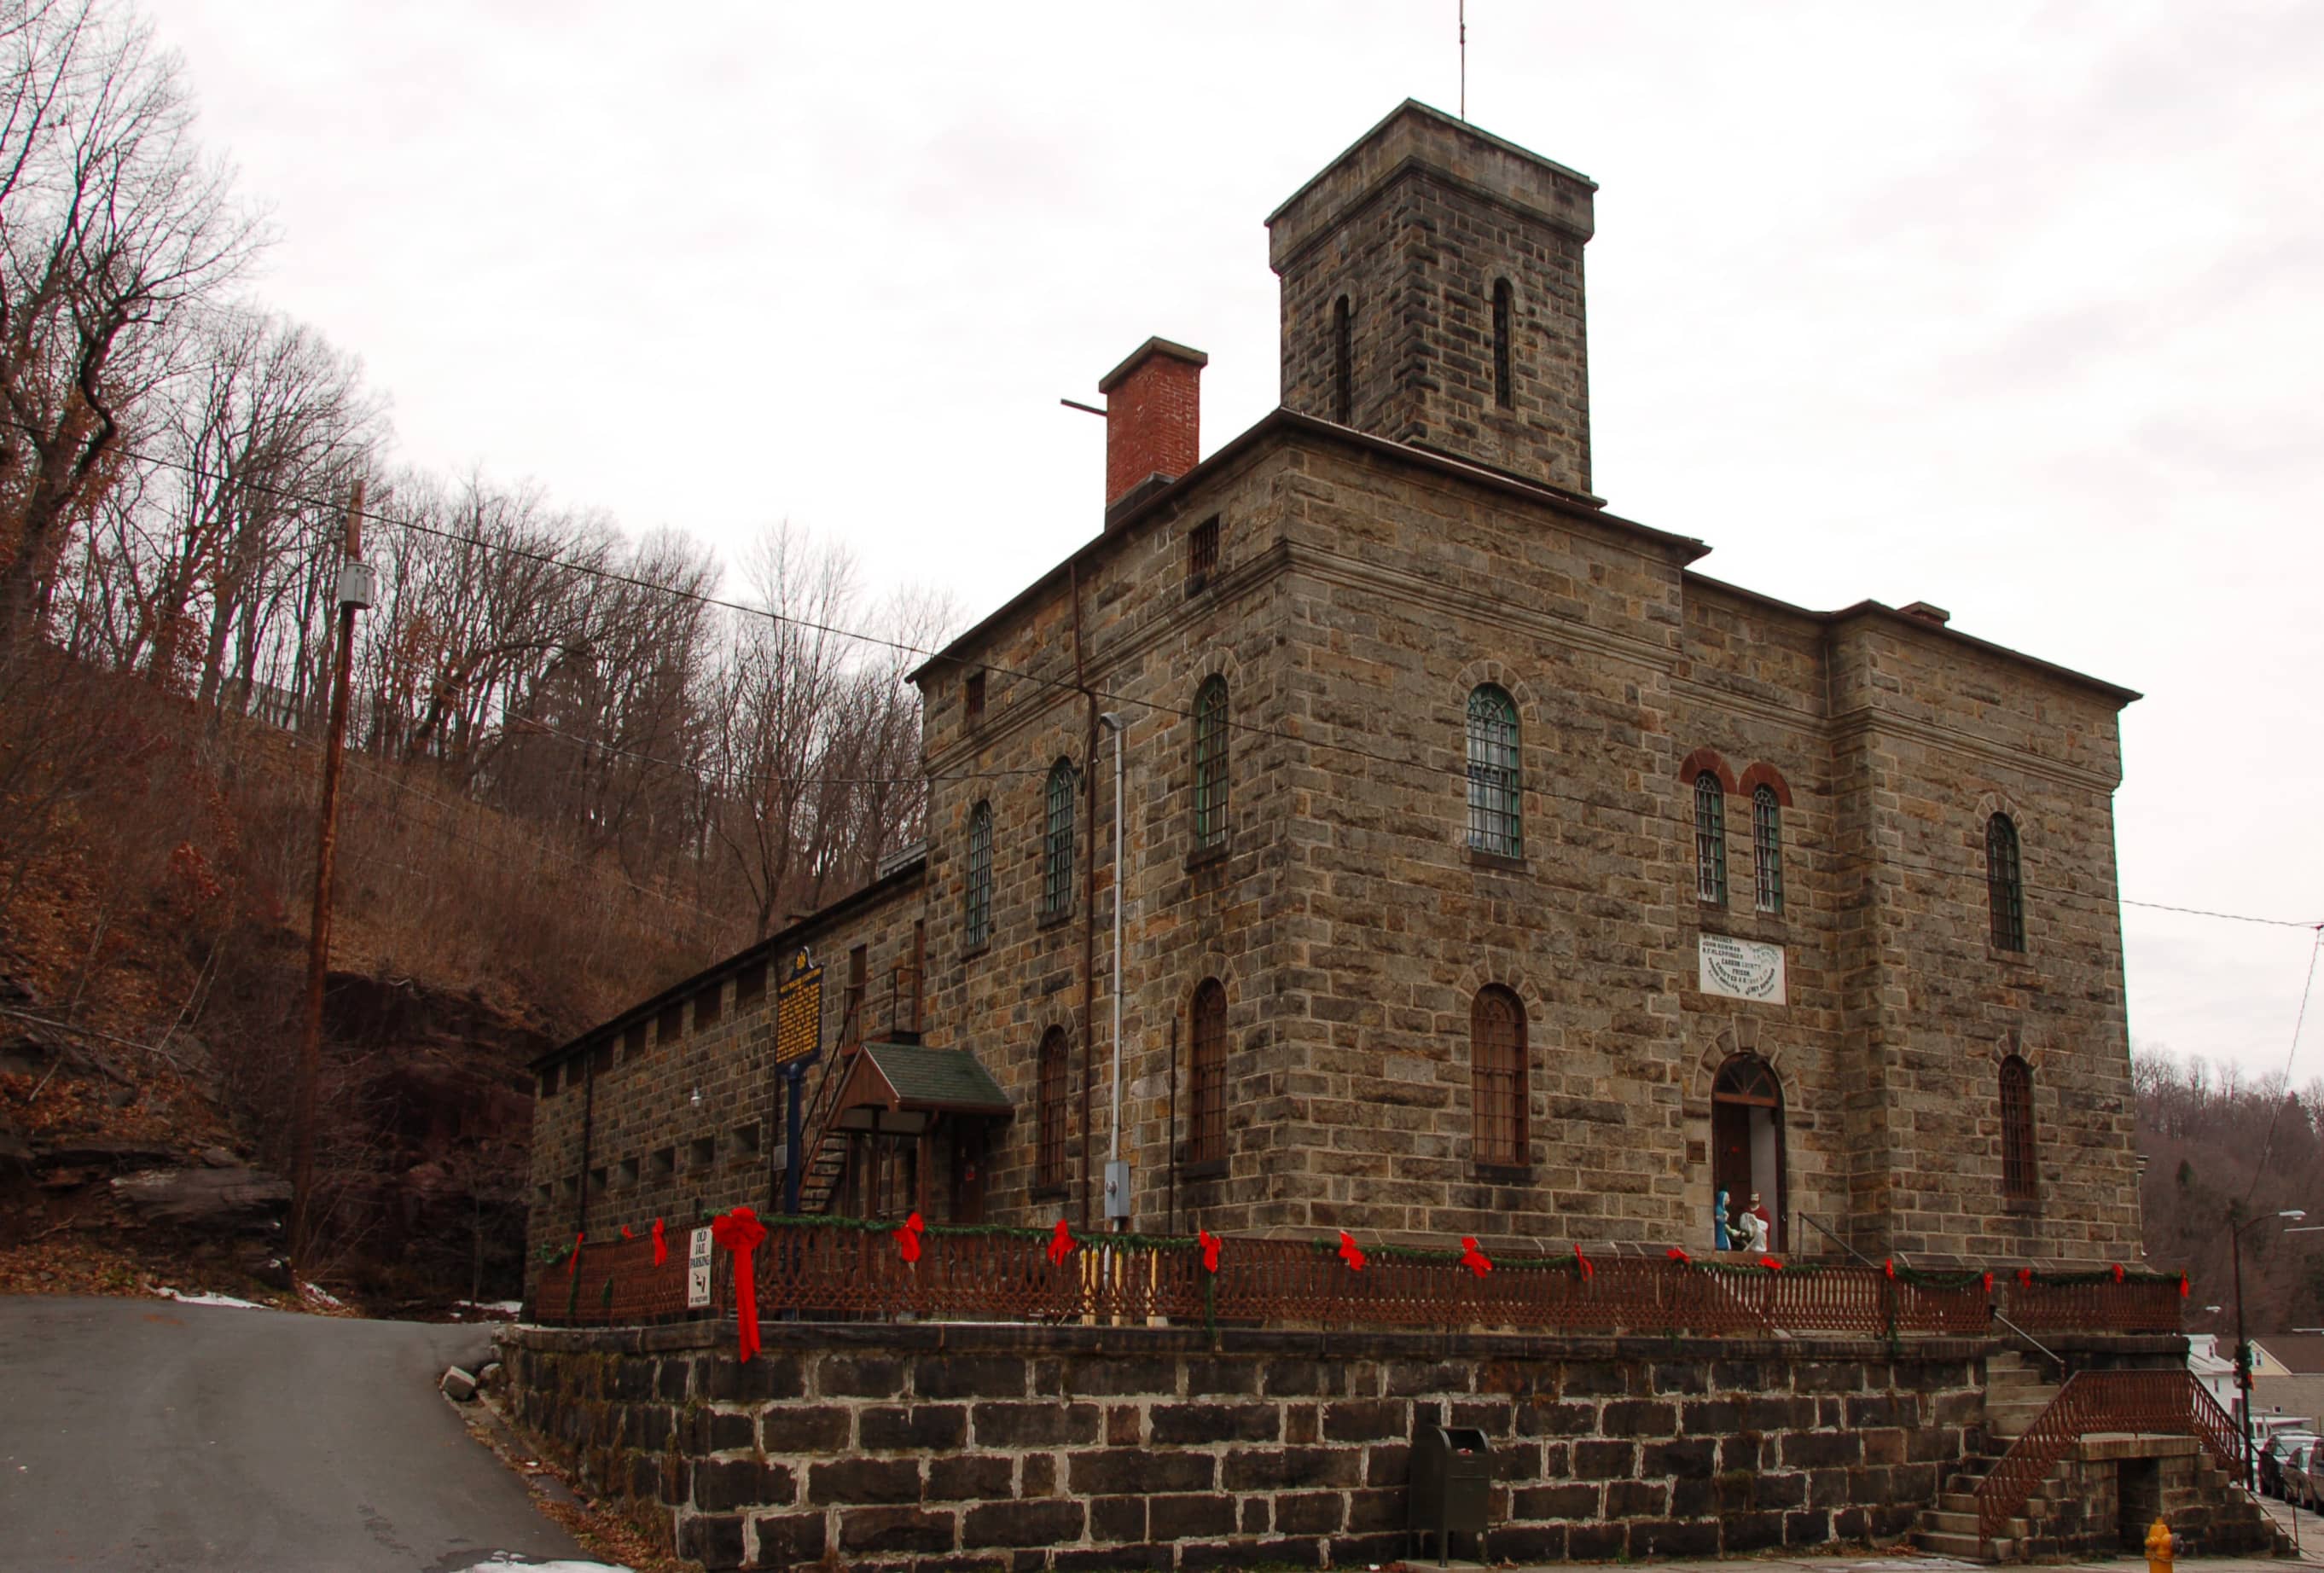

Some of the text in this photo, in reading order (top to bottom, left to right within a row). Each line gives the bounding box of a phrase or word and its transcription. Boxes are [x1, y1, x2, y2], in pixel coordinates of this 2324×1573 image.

[1722, 958, 1740, 966] CARBON
[697, 1228, 707, 1242] OLD
[689, 1255, 710, 1268] PARKING
